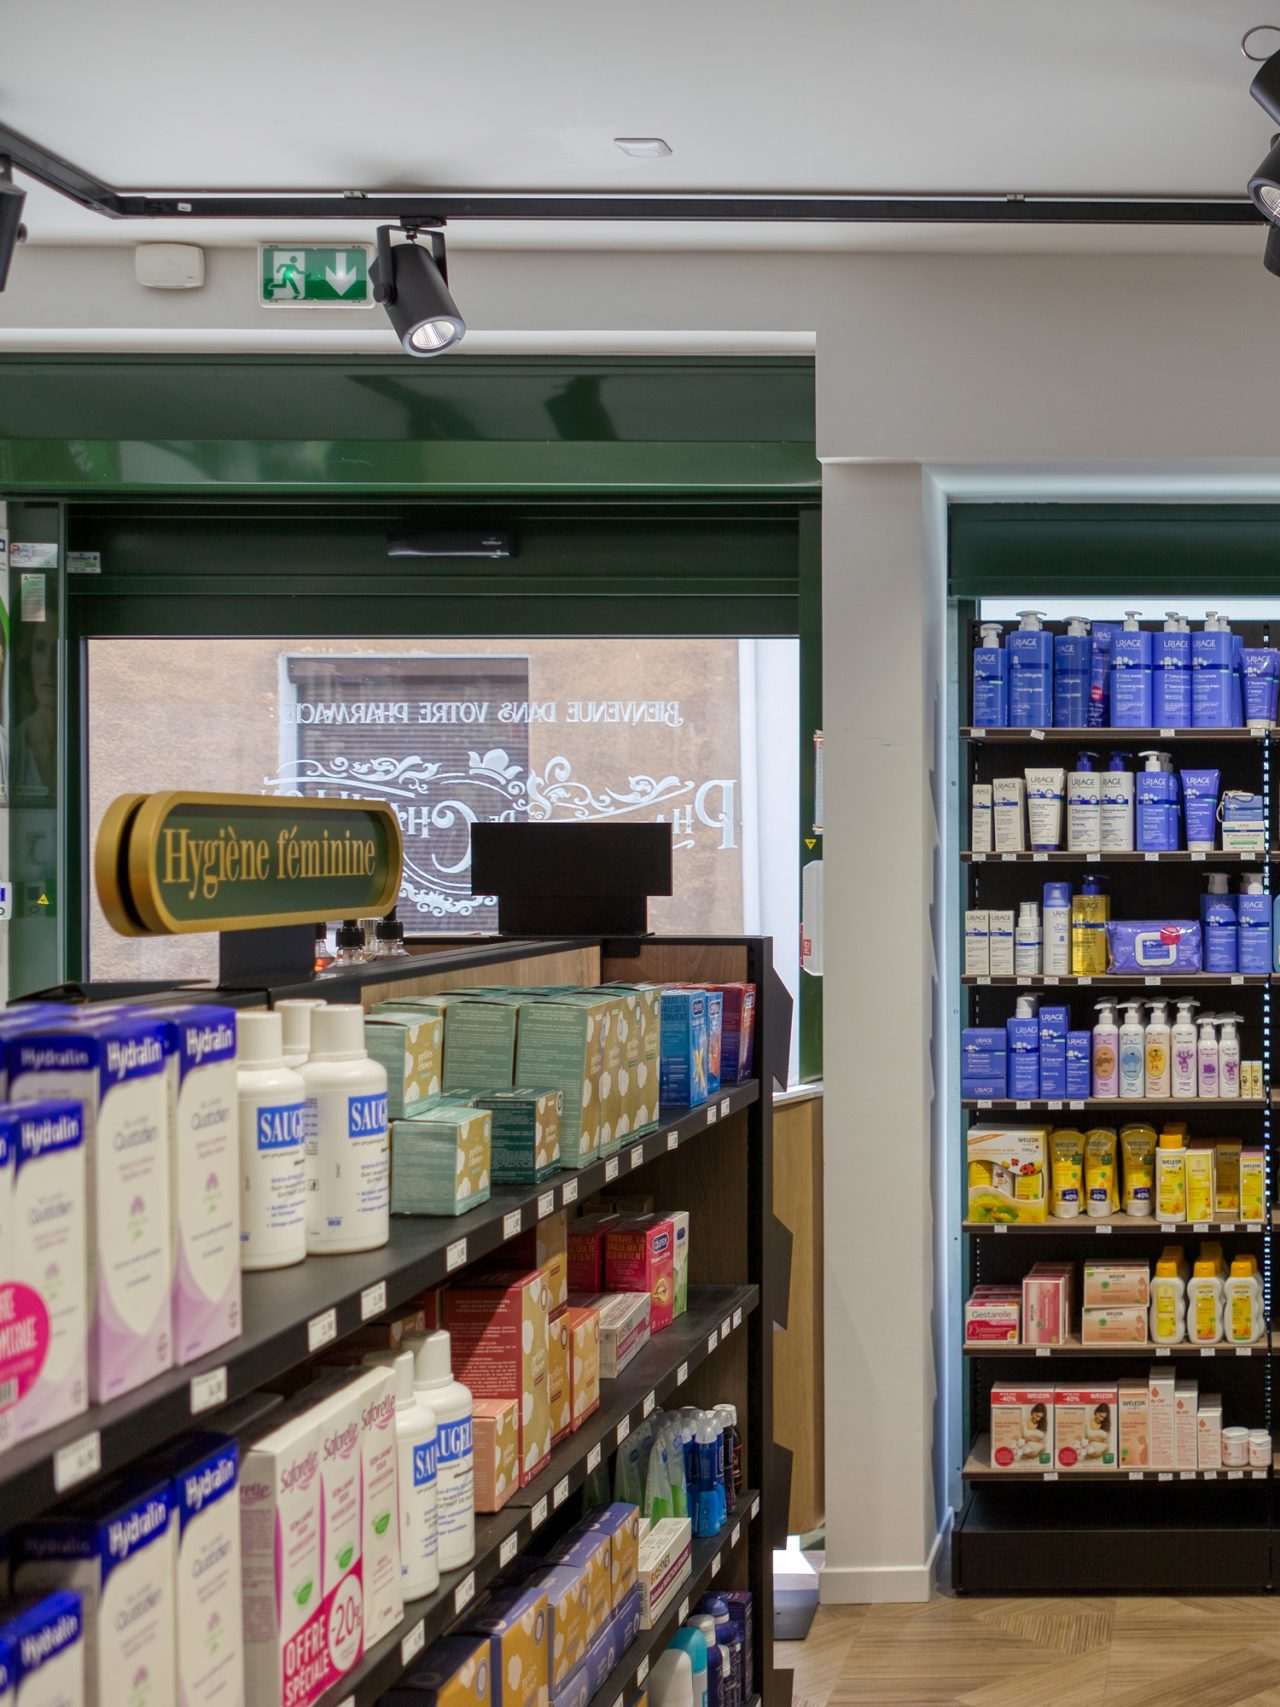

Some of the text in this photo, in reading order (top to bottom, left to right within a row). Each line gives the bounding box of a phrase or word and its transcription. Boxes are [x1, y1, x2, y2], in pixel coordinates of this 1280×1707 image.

[1116, 639, 1143, 648] URIAGE
[1246, 655, 1271, 664] URIAGE
[1031, 776, 1055, 784] URIAGE
[1072, 778, 1095, 786] URIAGE
[1143, 778, 1166, 786] URIAGE
[1186, 777, 1210, 785] URIAGE
[162, 825, 270, 899] Hygiène
[276, 821, 377, 882] féminine
[1041, 1013, 1063, 1021] URIAGE
[106, 1037, 163, 1078] Hydralin
[186, 1025, 234, 1058] Hydralin
[20, 1116, 80, 1154] Hydralin
[971, 1311, 1012, 1319] Gestarelle
[361, 1394, 396, 1431] Saforelle
[322, 1422, 359, 1463] Saforelle
[185, 1456, 236, 1502] Hydralin
[280, 1450, 318, 1493] Saforelle
[108, 1499, 168, 1557] Hydralin
[21, 1615, 79, 1659] Hydralin
[286, 1614, 326, 1677] OFFRE
